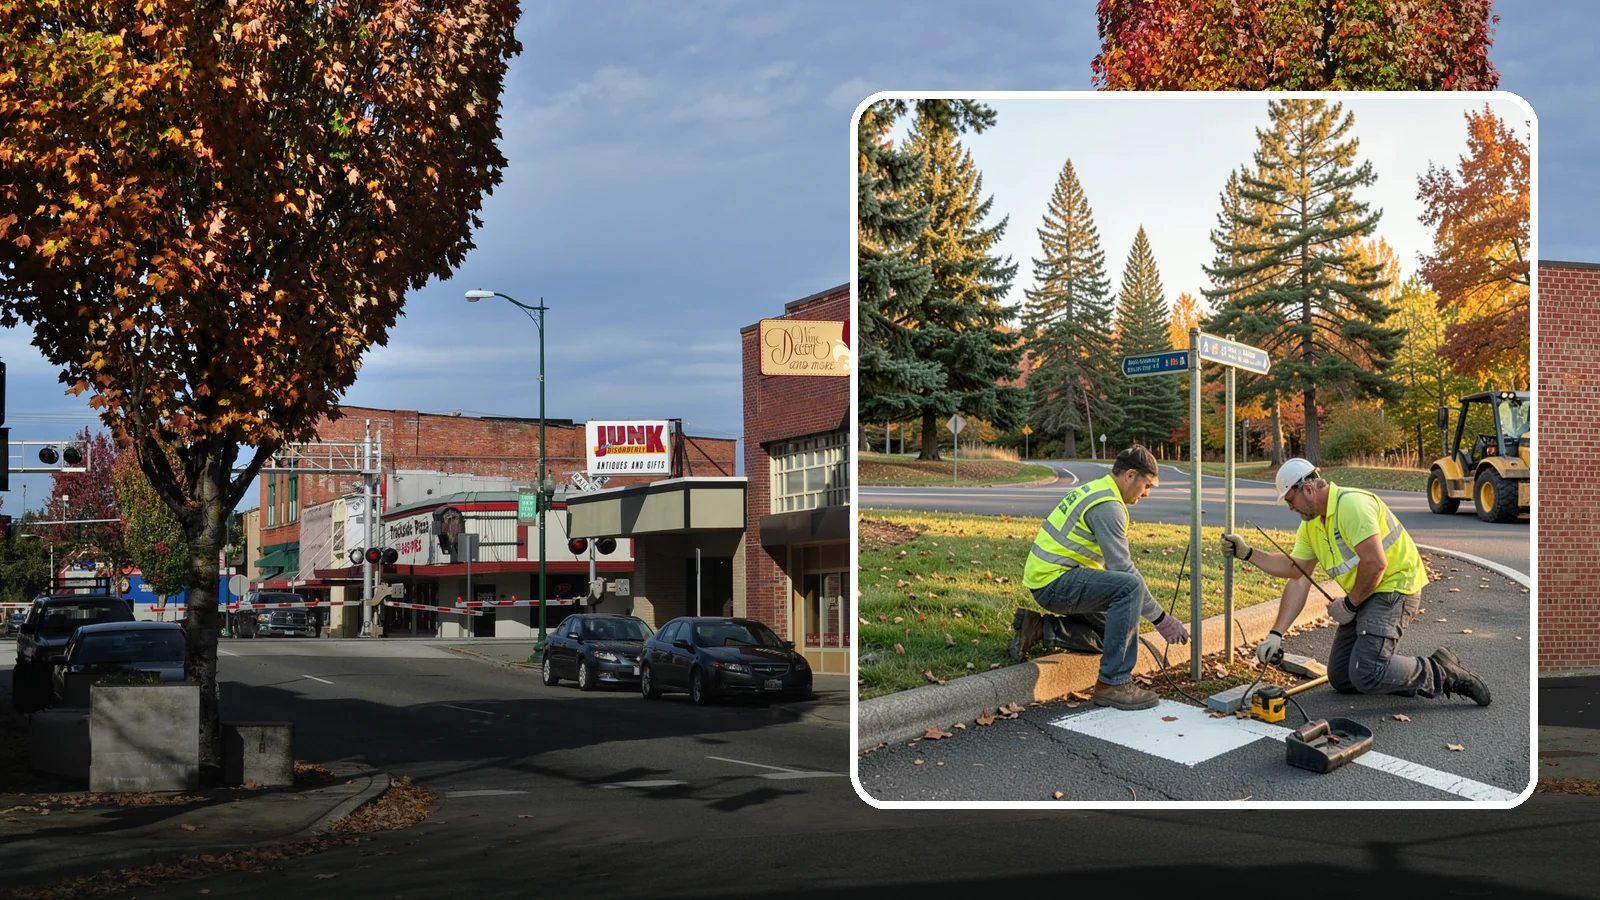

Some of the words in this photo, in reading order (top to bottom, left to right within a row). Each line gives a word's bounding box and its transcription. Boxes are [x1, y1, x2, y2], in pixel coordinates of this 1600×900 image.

[595, 425, 665, 457] JUNK
[607, 446, 646, 454] DISORDERLY
[597, 461, 628, 470] ANTIQUES
[631, 461, 643, 470] AND
[647, 460, 665, 470] GIFTS
[590, 476, 608, 491] SING
[390, 521, 413, 540] Trackside
[414, 519, 429, 535] Pizza
